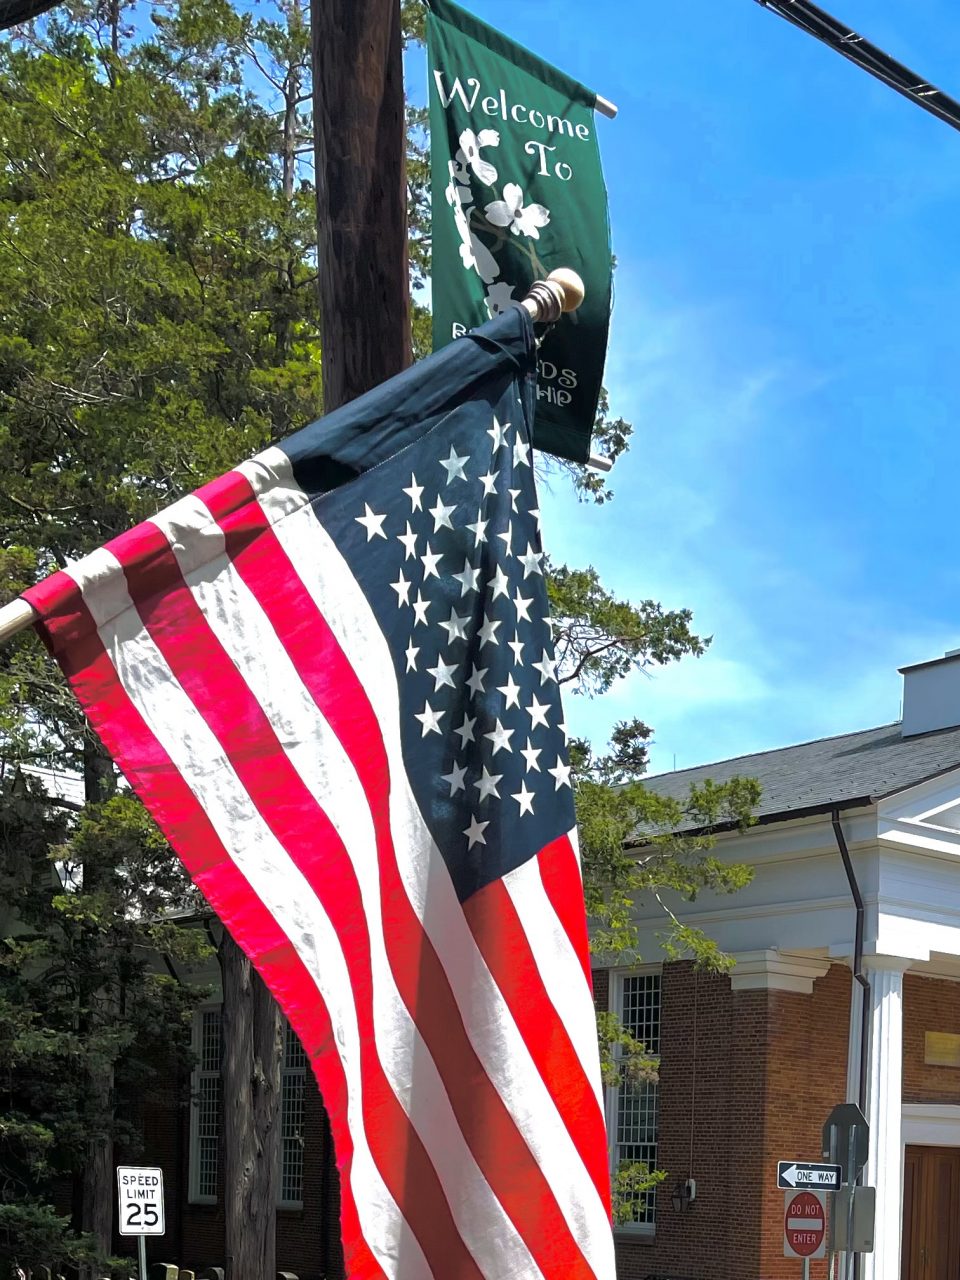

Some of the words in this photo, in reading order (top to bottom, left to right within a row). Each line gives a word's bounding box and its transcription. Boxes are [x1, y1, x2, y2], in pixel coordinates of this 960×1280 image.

[433, 69, 590, 141] Welcome
[524, 140, 573, 181] To
[122, 1175, 159, 1186] SPEED
[796, 1171, 813, 1181] ONE
[818, 1172, 836, 1183] WAY
[126, 1189, 156, 1199] LIMIT
[126, 1203, 159, 1226] 25
[791, 1204, 802, 1215] DO
[805, 1204, 820, 1215] NOT
[793, 1233, 817, 1244] ENTER
